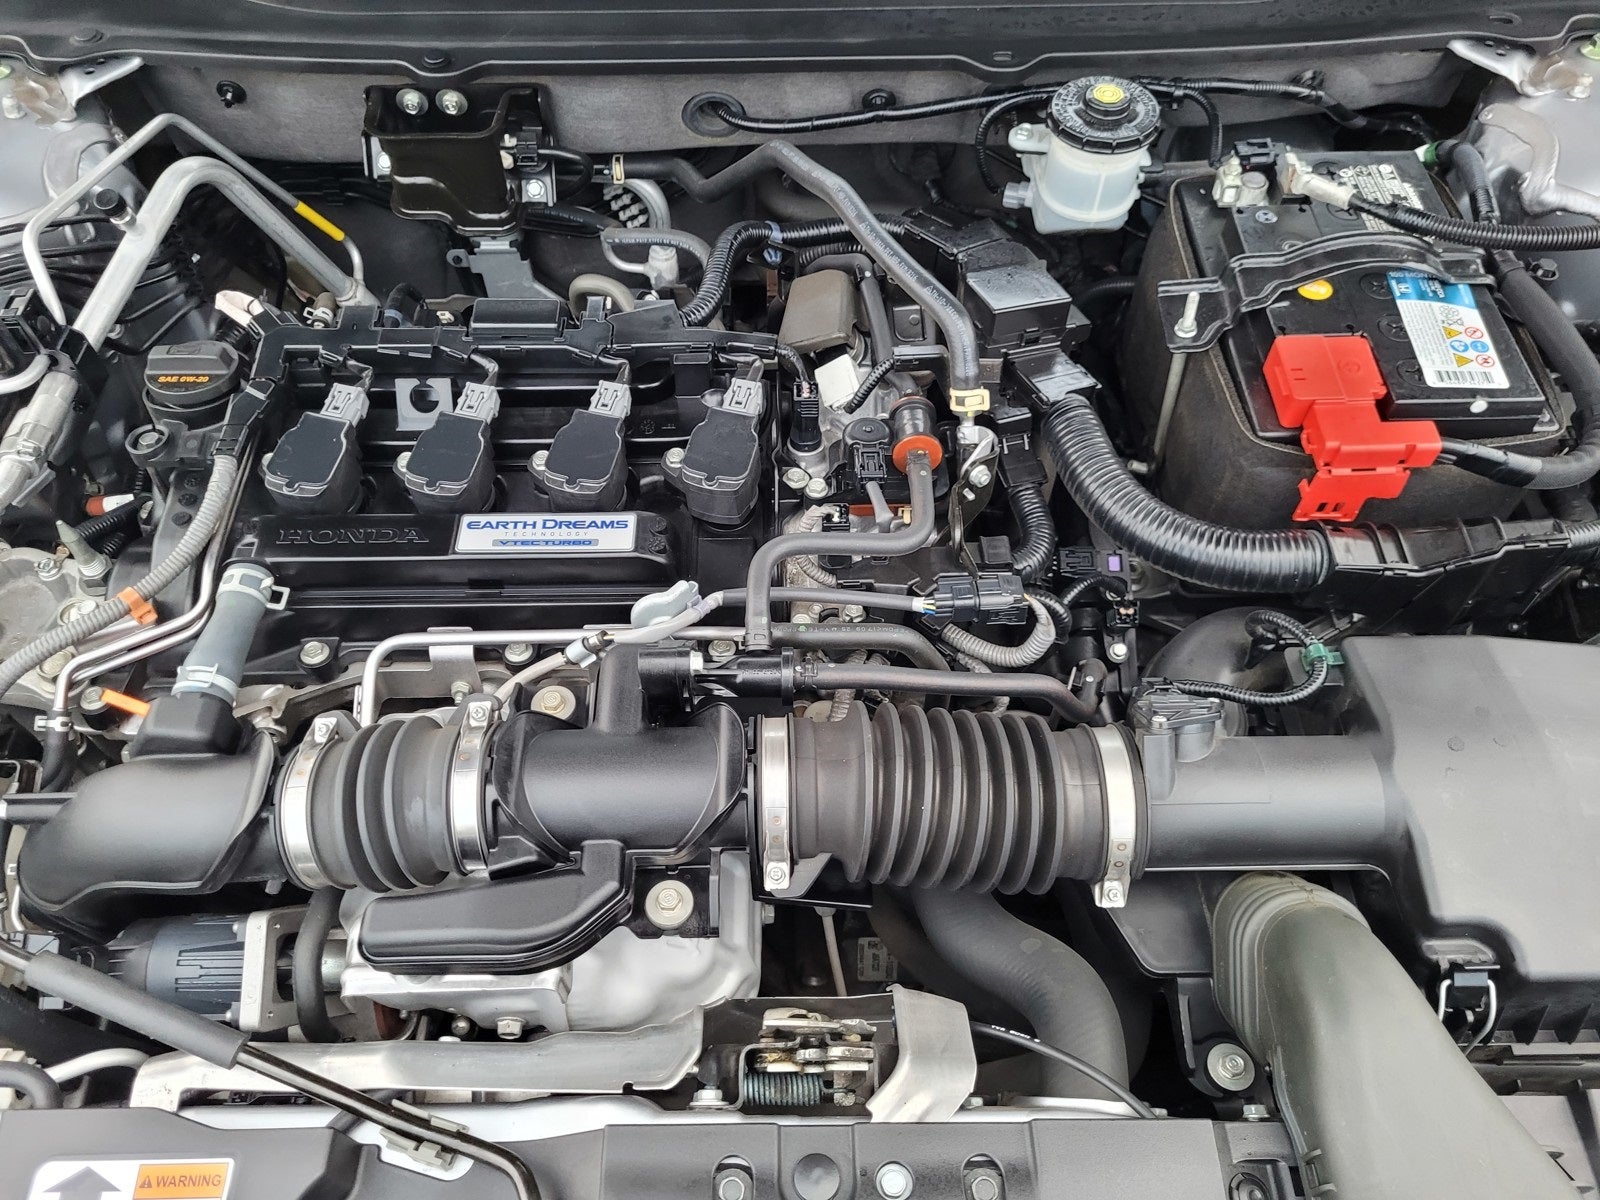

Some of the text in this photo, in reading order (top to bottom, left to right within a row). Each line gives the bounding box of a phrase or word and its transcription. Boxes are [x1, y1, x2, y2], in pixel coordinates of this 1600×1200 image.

[466, 519, 629, 530] EARTH DREAMS
[275, 527, 430, 544] HONDA
[155, 1174, 222, 1188] WARNING
